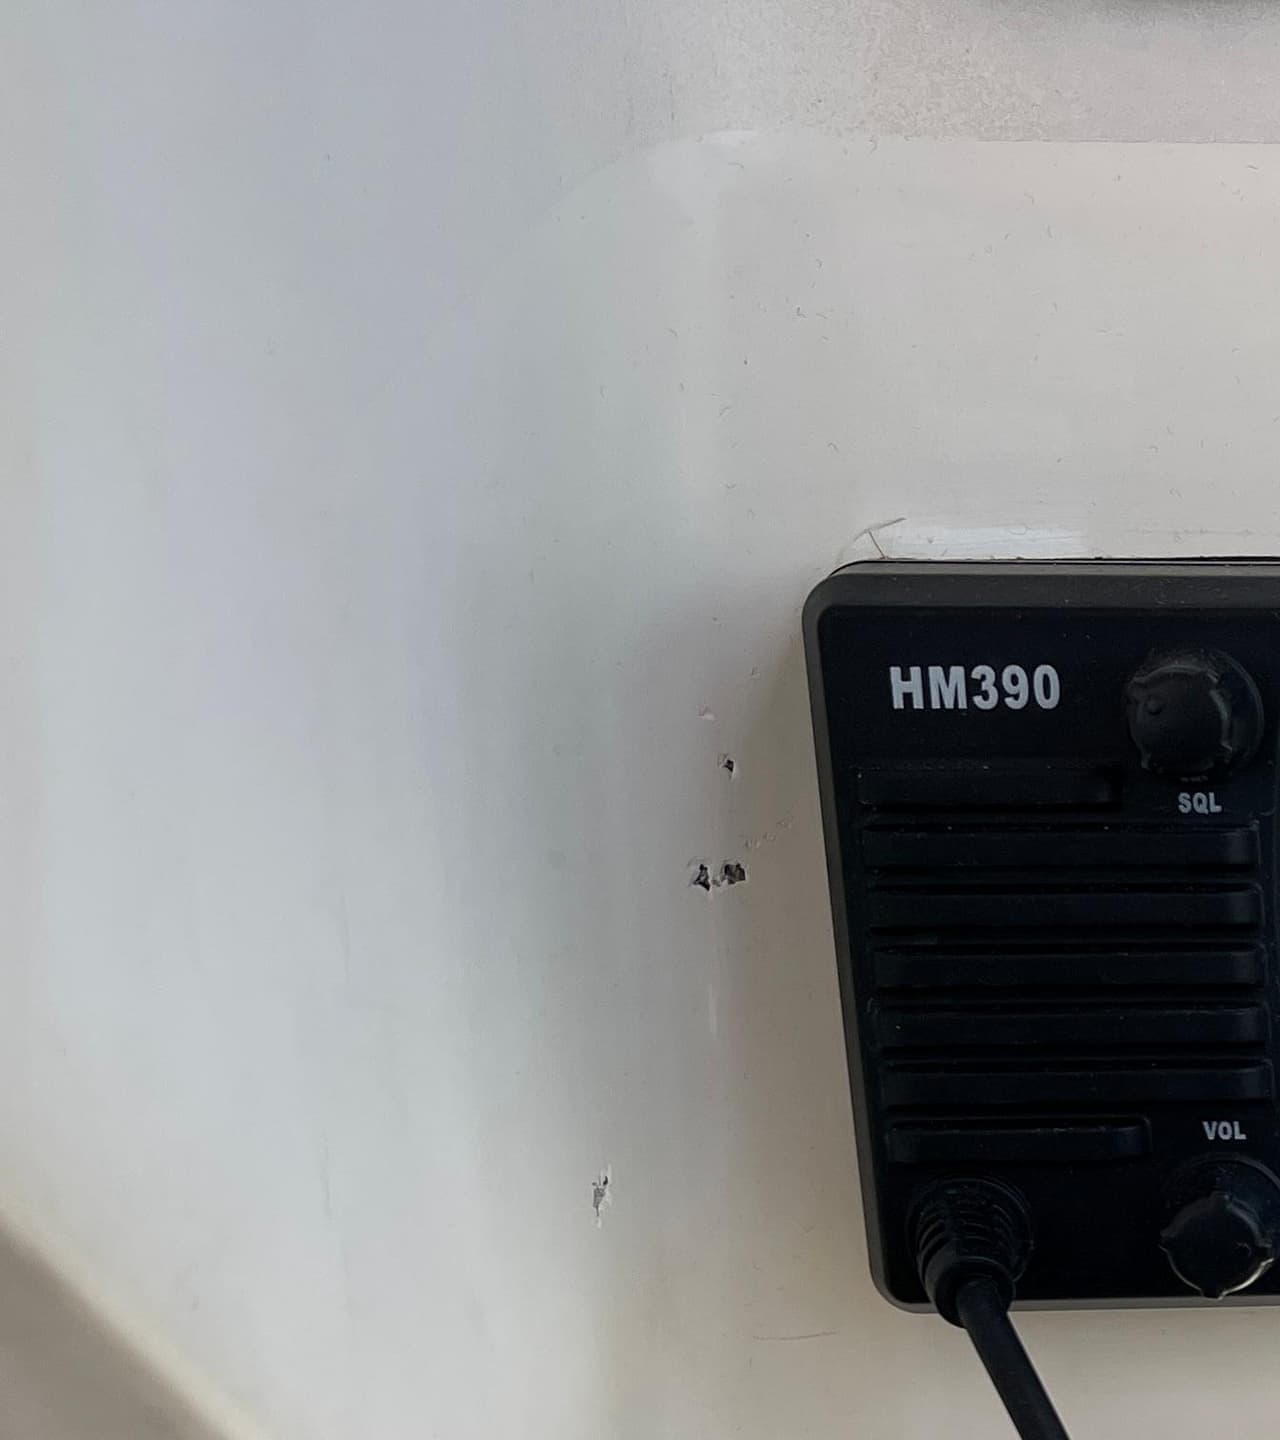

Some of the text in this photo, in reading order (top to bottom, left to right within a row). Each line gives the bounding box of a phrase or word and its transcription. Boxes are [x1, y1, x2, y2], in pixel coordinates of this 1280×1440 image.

[889, 664, 1061, 711] HM390
[1178, 792, 1222, 815] SQL
[1203, 1121, 1247, 1142] VOL
